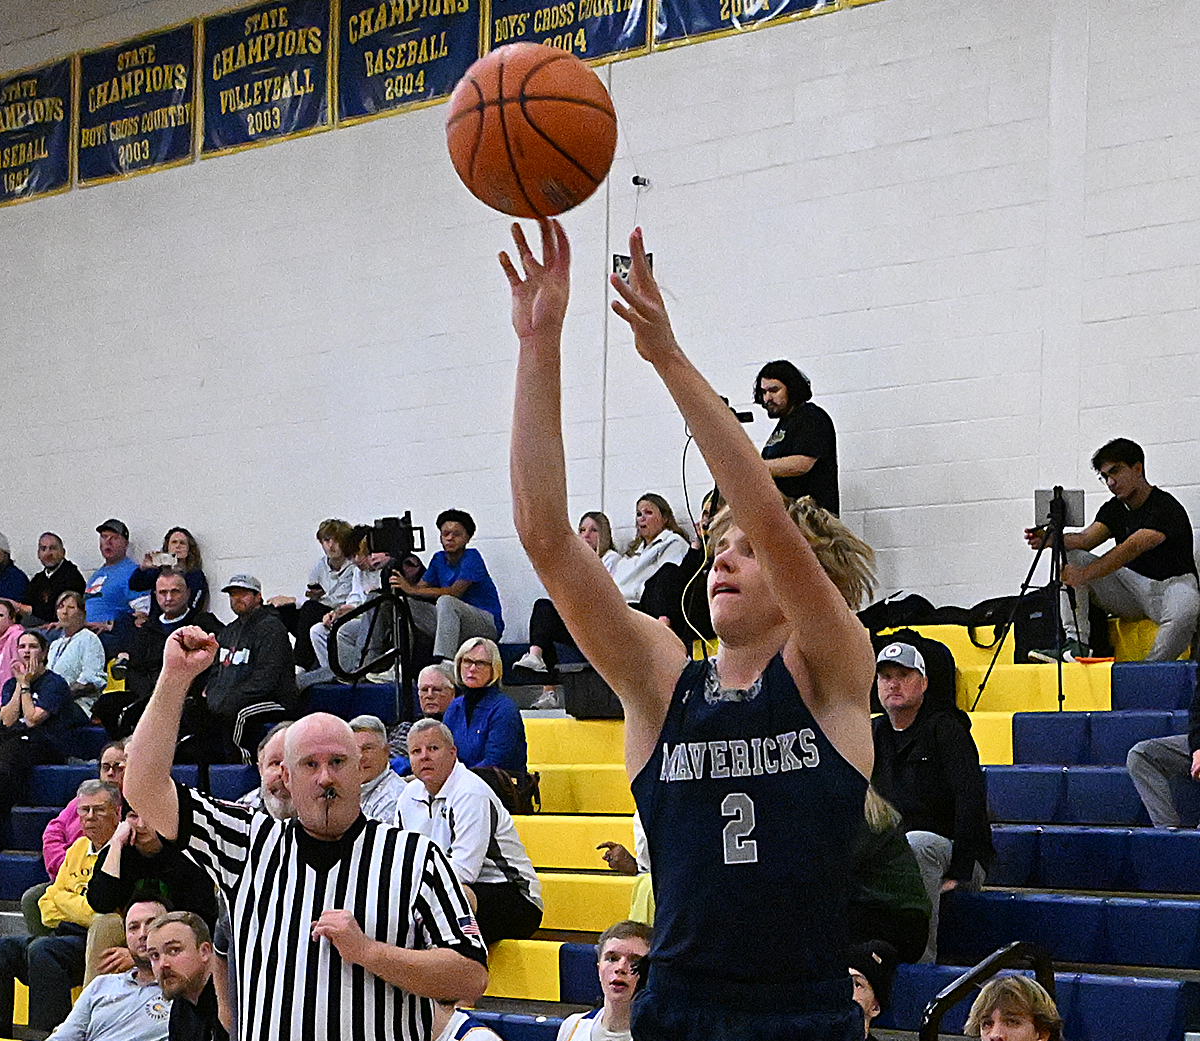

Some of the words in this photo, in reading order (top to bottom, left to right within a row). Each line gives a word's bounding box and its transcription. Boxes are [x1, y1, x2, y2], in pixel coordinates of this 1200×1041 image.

[244, 6, 289, 36] STATE
[534, 2, 575, 33] CROSS
[117, 44, 156, 71] STATE
[212, 26, 322, 81] CHAMPIONS
[364, 31, 448, 77] BASEBALL
[88, 63, 187, 114] CHAMPIONS
[220, 68, 315, 115] VOLLEYBALL
[385, 69, 425, 100] 2004
[247, 106, 281, 136] 2003
[118, 138, 150, 167] 2003
[659, 727, 820, 783] MAVERICKS
[720, 792, 759, 865] 2
